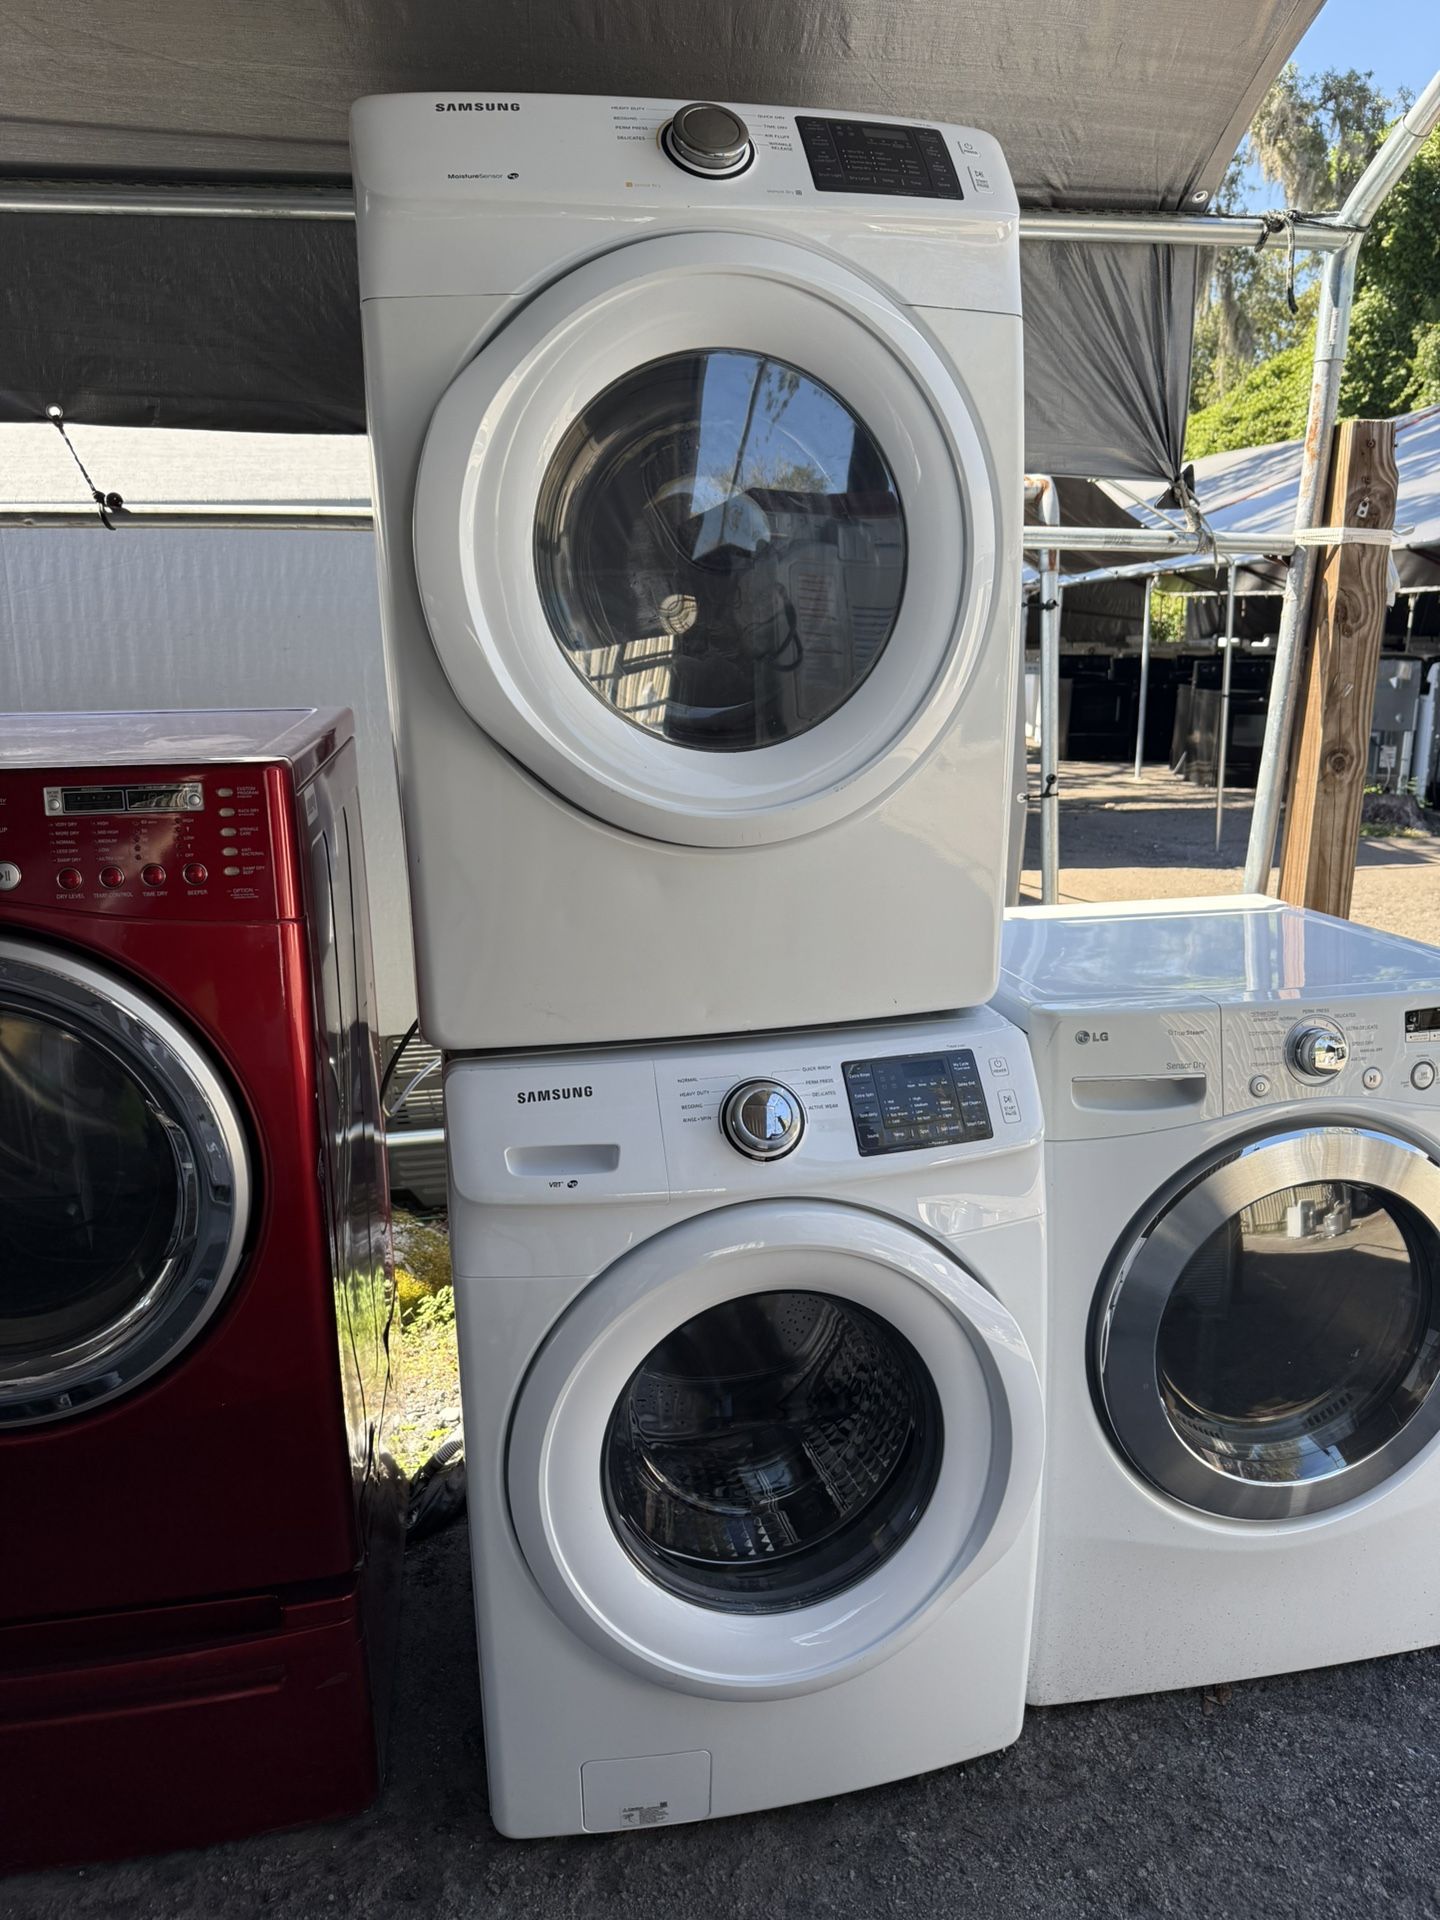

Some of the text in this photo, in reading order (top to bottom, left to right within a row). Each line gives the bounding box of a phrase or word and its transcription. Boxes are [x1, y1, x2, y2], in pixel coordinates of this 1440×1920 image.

[435, 102, 520, 112] SAMSUNG
[1092, 1032, 1109, 1042] LG
[1166, 1061, 1207, 1070] Sensor Dry
[517, 1085, 593, 1104] SAMSUNG
